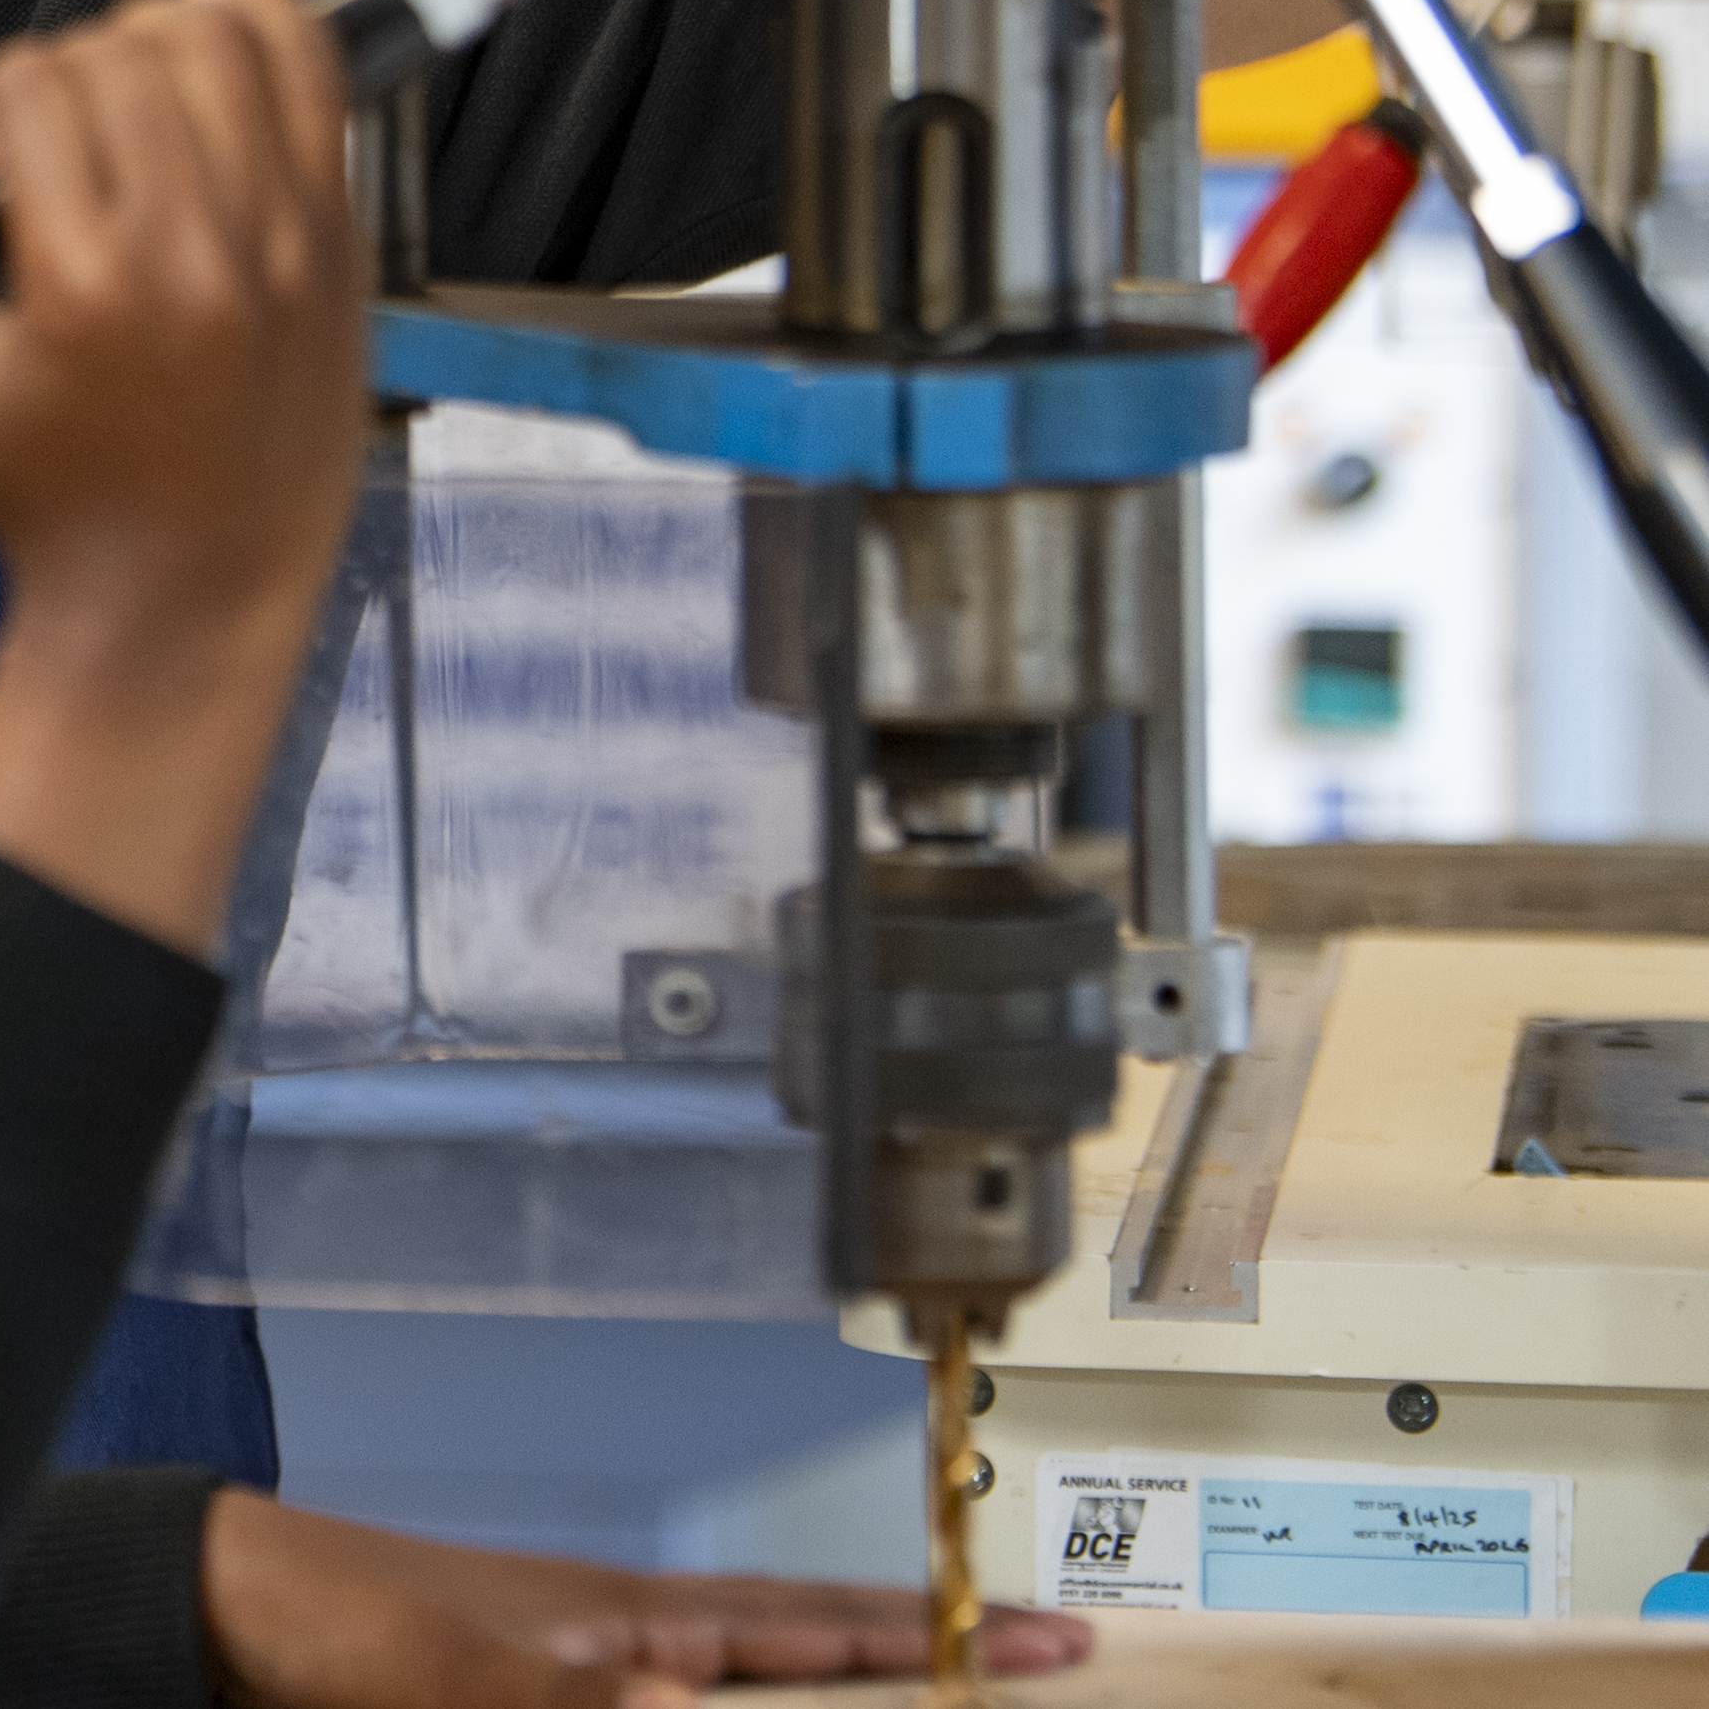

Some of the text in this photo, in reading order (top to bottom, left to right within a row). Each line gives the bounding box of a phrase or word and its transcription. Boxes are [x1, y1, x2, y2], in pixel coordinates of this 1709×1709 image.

[1059, 1475, 1189, 1492] ANNUAL SERVICE
[1353, 1500, 1375, 1510] TEST
[1353, 1530, 1378, 1540] NEXT
[1381, 1531, 1403, 1540] TEST
[1063, 1532, 1136, 1561] DCE
